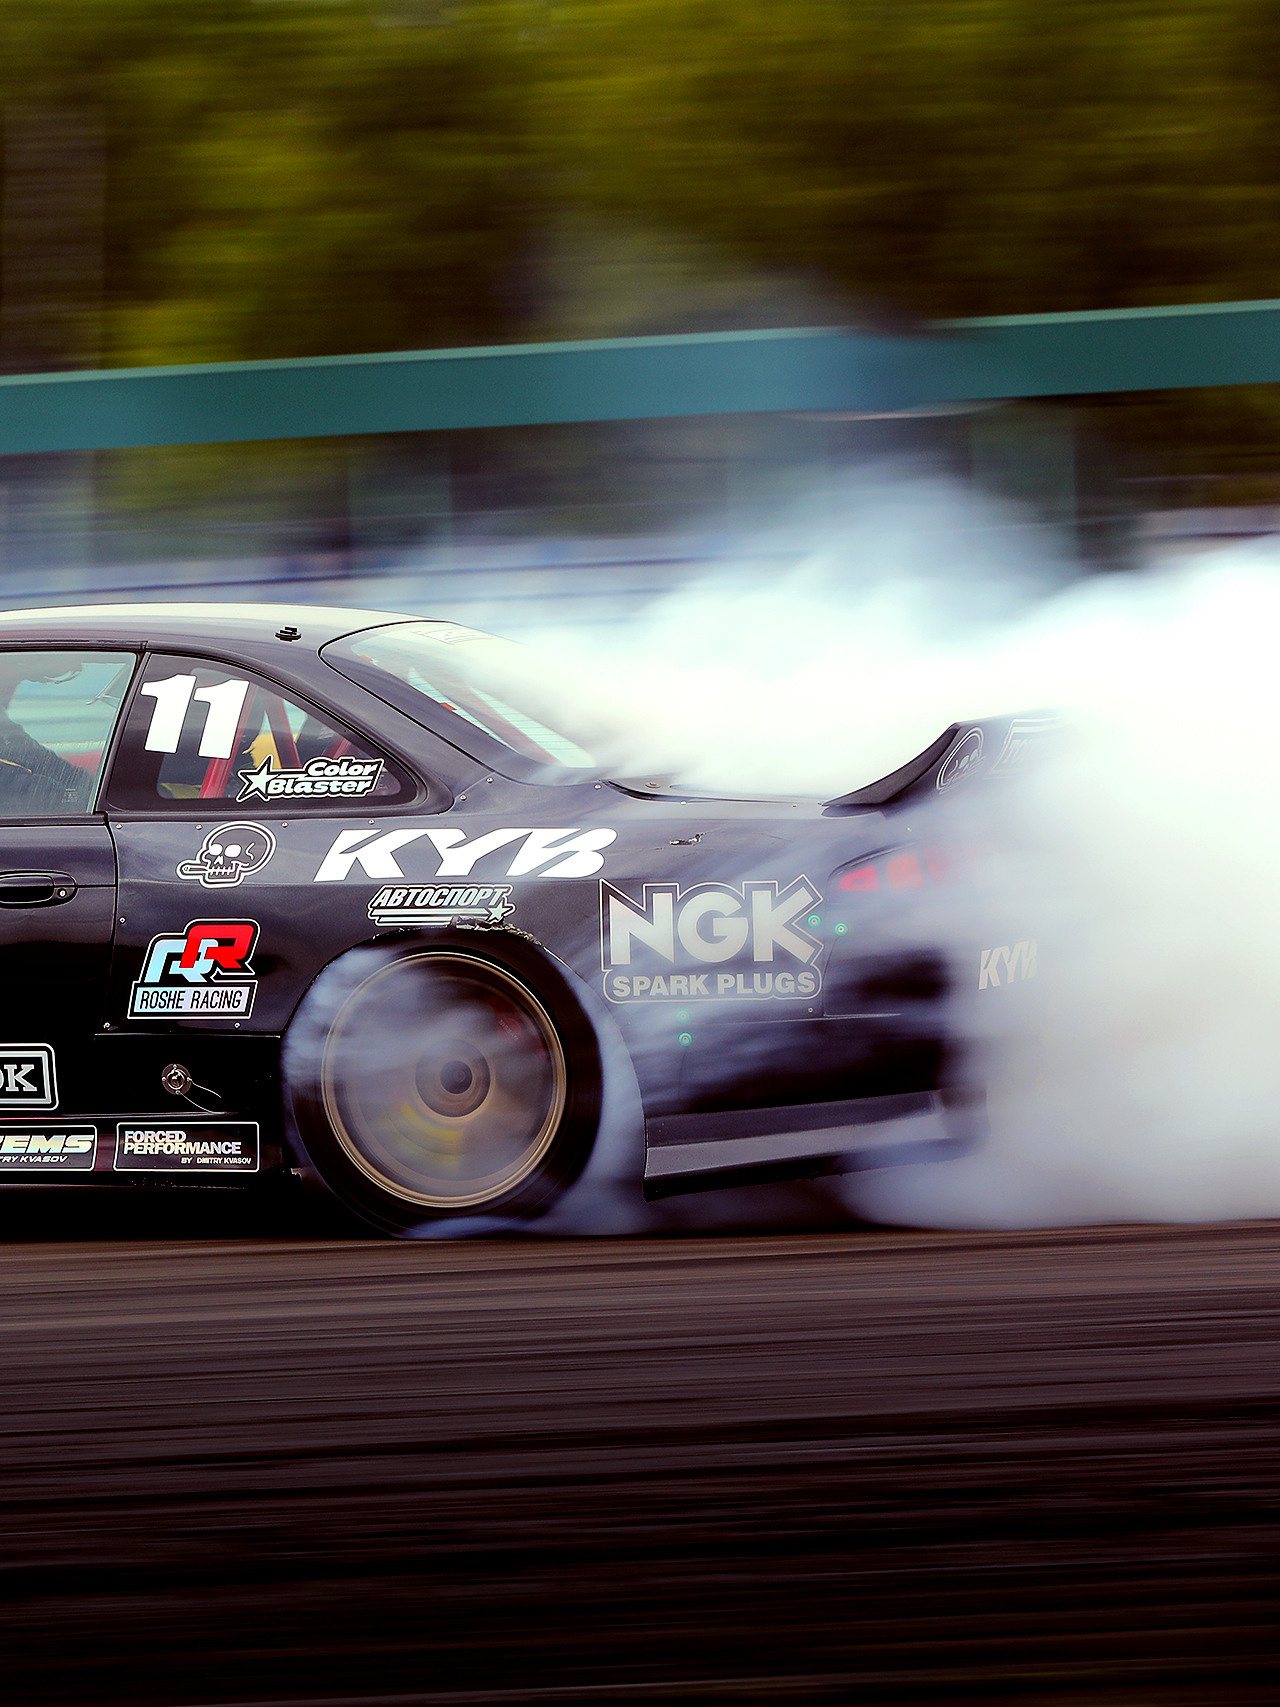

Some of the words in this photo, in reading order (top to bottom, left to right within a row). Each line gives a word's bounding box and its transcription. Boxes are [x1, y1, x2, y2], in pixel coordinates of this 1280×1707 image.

[140, 673, 250, 760] 11
[307, 761, 379, 777] Color
[266, 779, 372, 795] Blaster
[313, 827, 618, 882] KYB
[372, 888, 509, 907] АВТОСПОРТ
[608, 886, 816, 965] NGK
[612, 974, 709, 998] SPARK
[717, 971, 816, 995] PLUGS
[140, 990, 186, 1010] ROSHE
[190, 990, 243, 1010] RACING
[124, 1130, 187, 1143] FORCED
[123, 1141, 242, 1155] PERFORMANCE
[19, 1155, 68, 1163] KVASOV
[181, 1157, 193, 1165] BY
[196, 1157, 223, 1165] DMITRY
[223, 1157, 252, 1165] KVASOV
